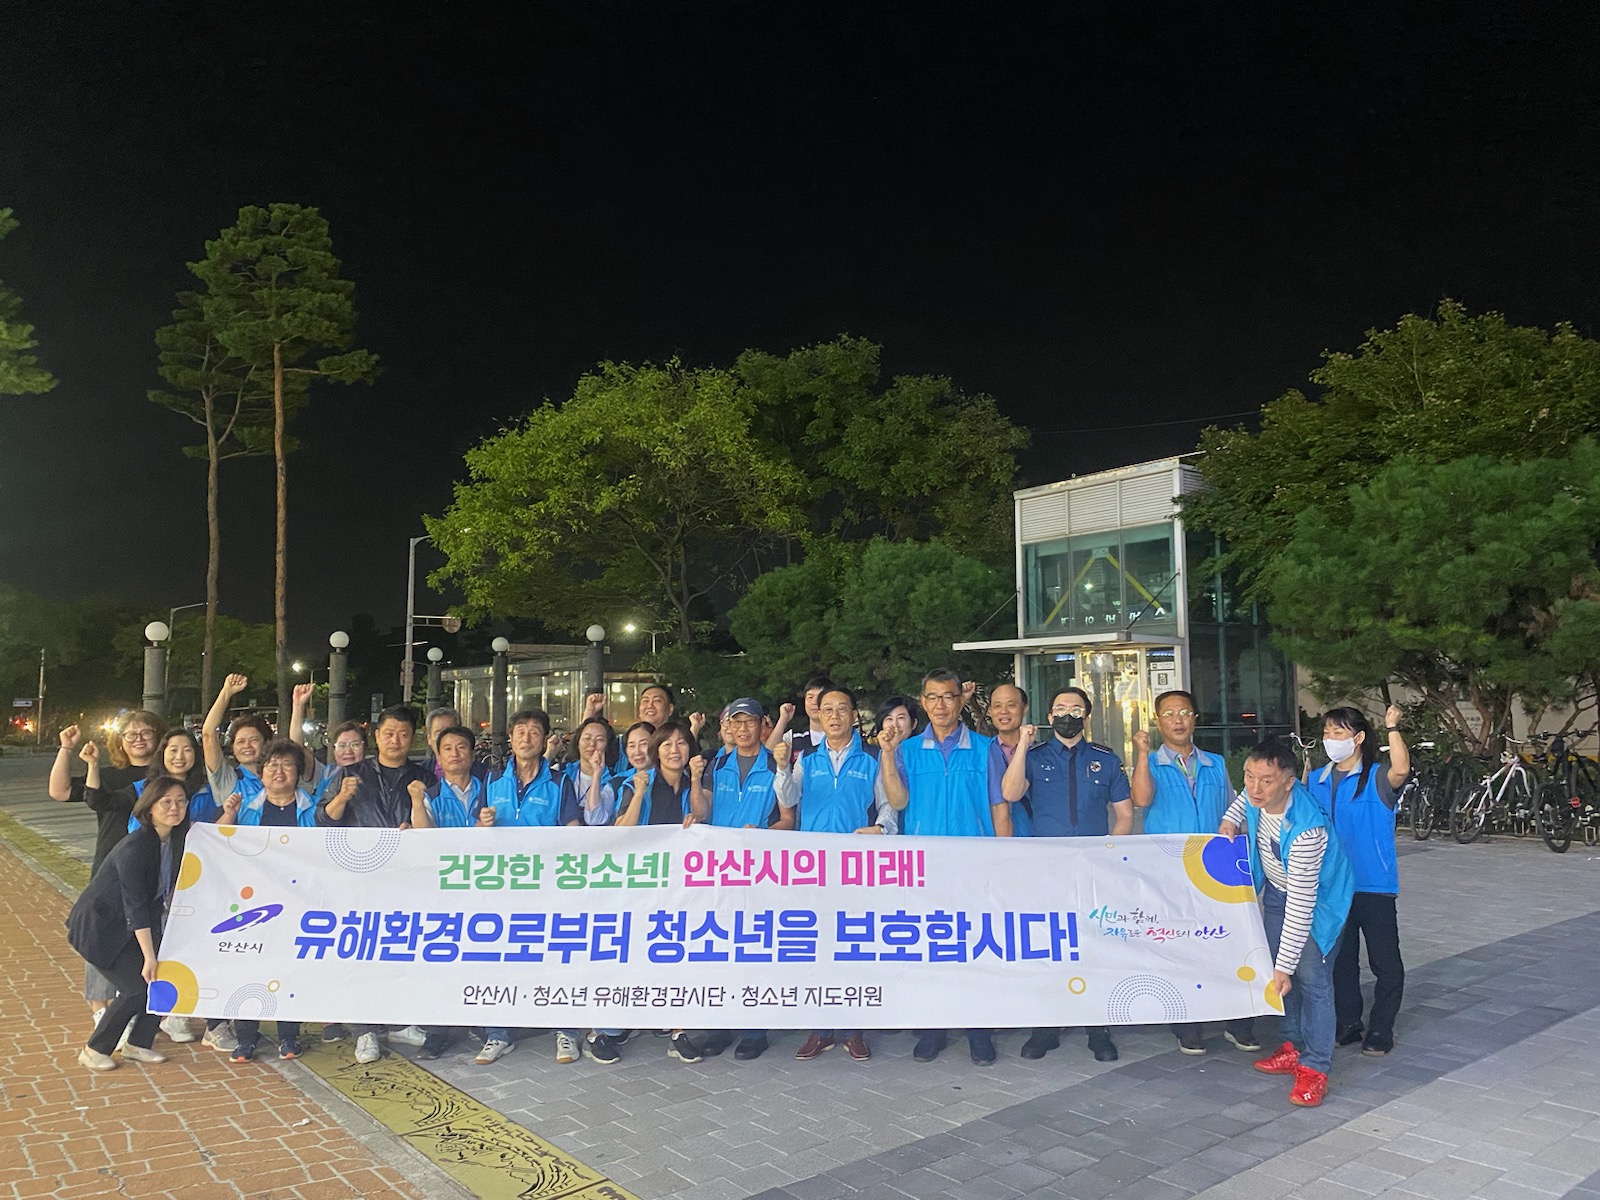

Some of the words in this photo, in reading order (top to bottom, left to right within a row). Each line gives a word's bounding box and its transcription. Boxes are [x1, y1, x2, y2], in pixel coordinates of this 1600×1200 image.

[438, 853, 545, 891] 건강한
[554, 852, 670, 890] 청소년!
[683, 849, 827, 888] 안산시의
[840, 849, 925, 888] 미래!
[1089, 905, 1129, 928] 시민과
[293, 910, 632, 965] 유해환경으로부터
[646, 909, 819, 964] 청소년을
[833, 909, 1080, 964] 보호합시다!
[1103, 927, 1142, 943] 자유로운
[1145, 926, 1191, 943] 혁신도시
[1194, 925, 1231, 940] 안산
[218, 941, 264, 954] 안산시
[463, 985, 518, 1007] 안산시
[532, 985, 588, 1007] 청소년
[592, 985, 727, 1008] 유해환경감시단
[741, 985, 798, 1008] 청소년
[803, 985, 883, 1008] 지도위원
